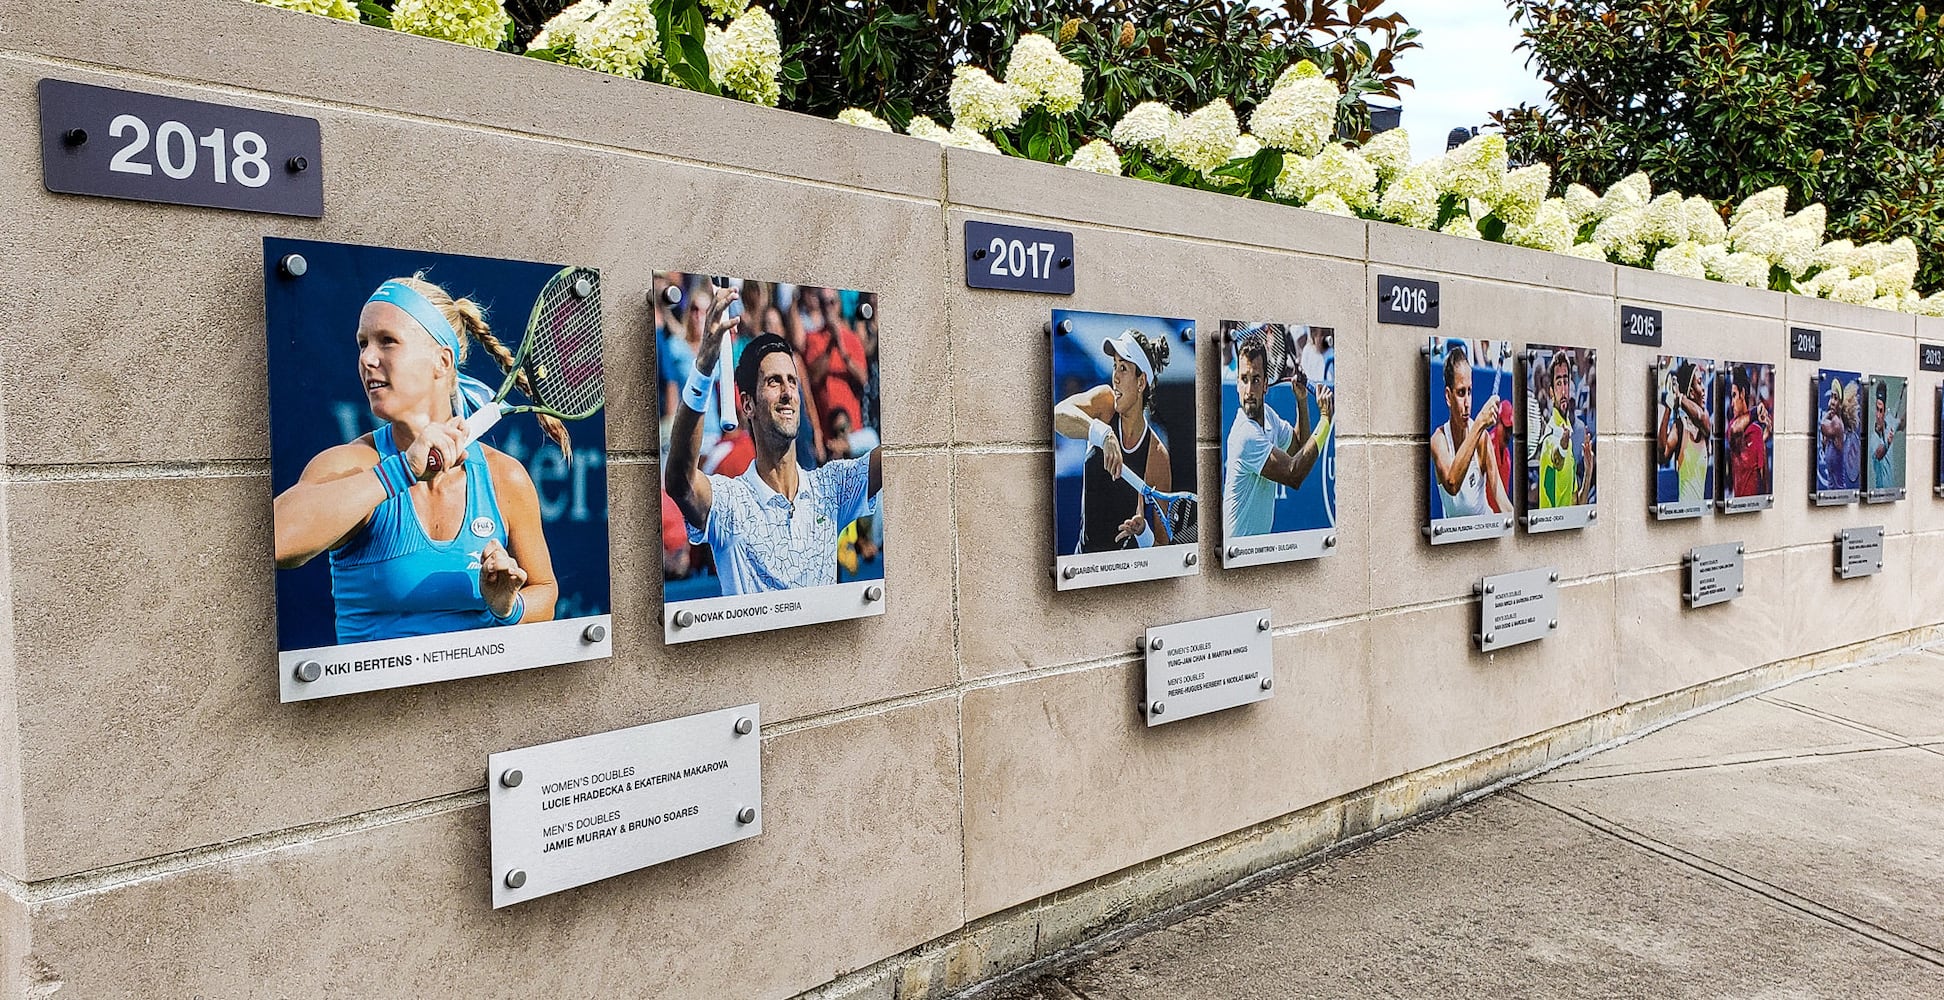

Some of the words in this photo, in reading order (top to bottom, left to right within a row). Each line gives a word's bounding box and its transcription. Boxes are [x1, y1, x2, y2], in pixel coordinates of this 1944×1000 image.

[109, 114, 271, 188] 2018
[989, 237, 1055, 279] 2017
[1391, 285, 1427, 315] 2016
[1630, 313, 1655, 337] 2015
[1797, 334, 1816, 352] 2014
[1925, 349, 1941, 365] 2013
[1100, 562, 1130, 572] MUGURUZA
[1134, 560, 1149, 569] SPAIN
[694, 611, 724, 624] NOVAK
[726, 606, 768, 620] DJOKOVIC
[774, 601, 802, 614] SERBIA
[325, 661, 350, 676] KIKI
[354, 655, 413, 674] BERTENS
[423, 643, 505, 664] NETHERLANDS
[1190, 642, 1212, 653] DOUBLES
[1193, 654, 1206, 663] CHAN
[1183, 672, 1206, 684] DOUBLES
[541, 776, 589, 795] WOMEN'S
[591, 766, 636, 784] DOUBLES
[542, 796, 571, 811] LUCIE
[573, 785, 624, 804] HRADECKA
[626, 782, 632, 792] &
[634, 771, 682, 790] EKATERINA
[683, 759, 729, 779] MAKAROVA
[543, 822, 574, 838] MEN'S
[576, 810, 621, 829] DOUBLES
[543, 838, 574, 853] JAMIE
[576, 826, 617, 845] MURRAY
[620, 824, 626, 834] &
[629, 815, 661, 832] BRUNO
[663, 805, 699, 823] SOARES
